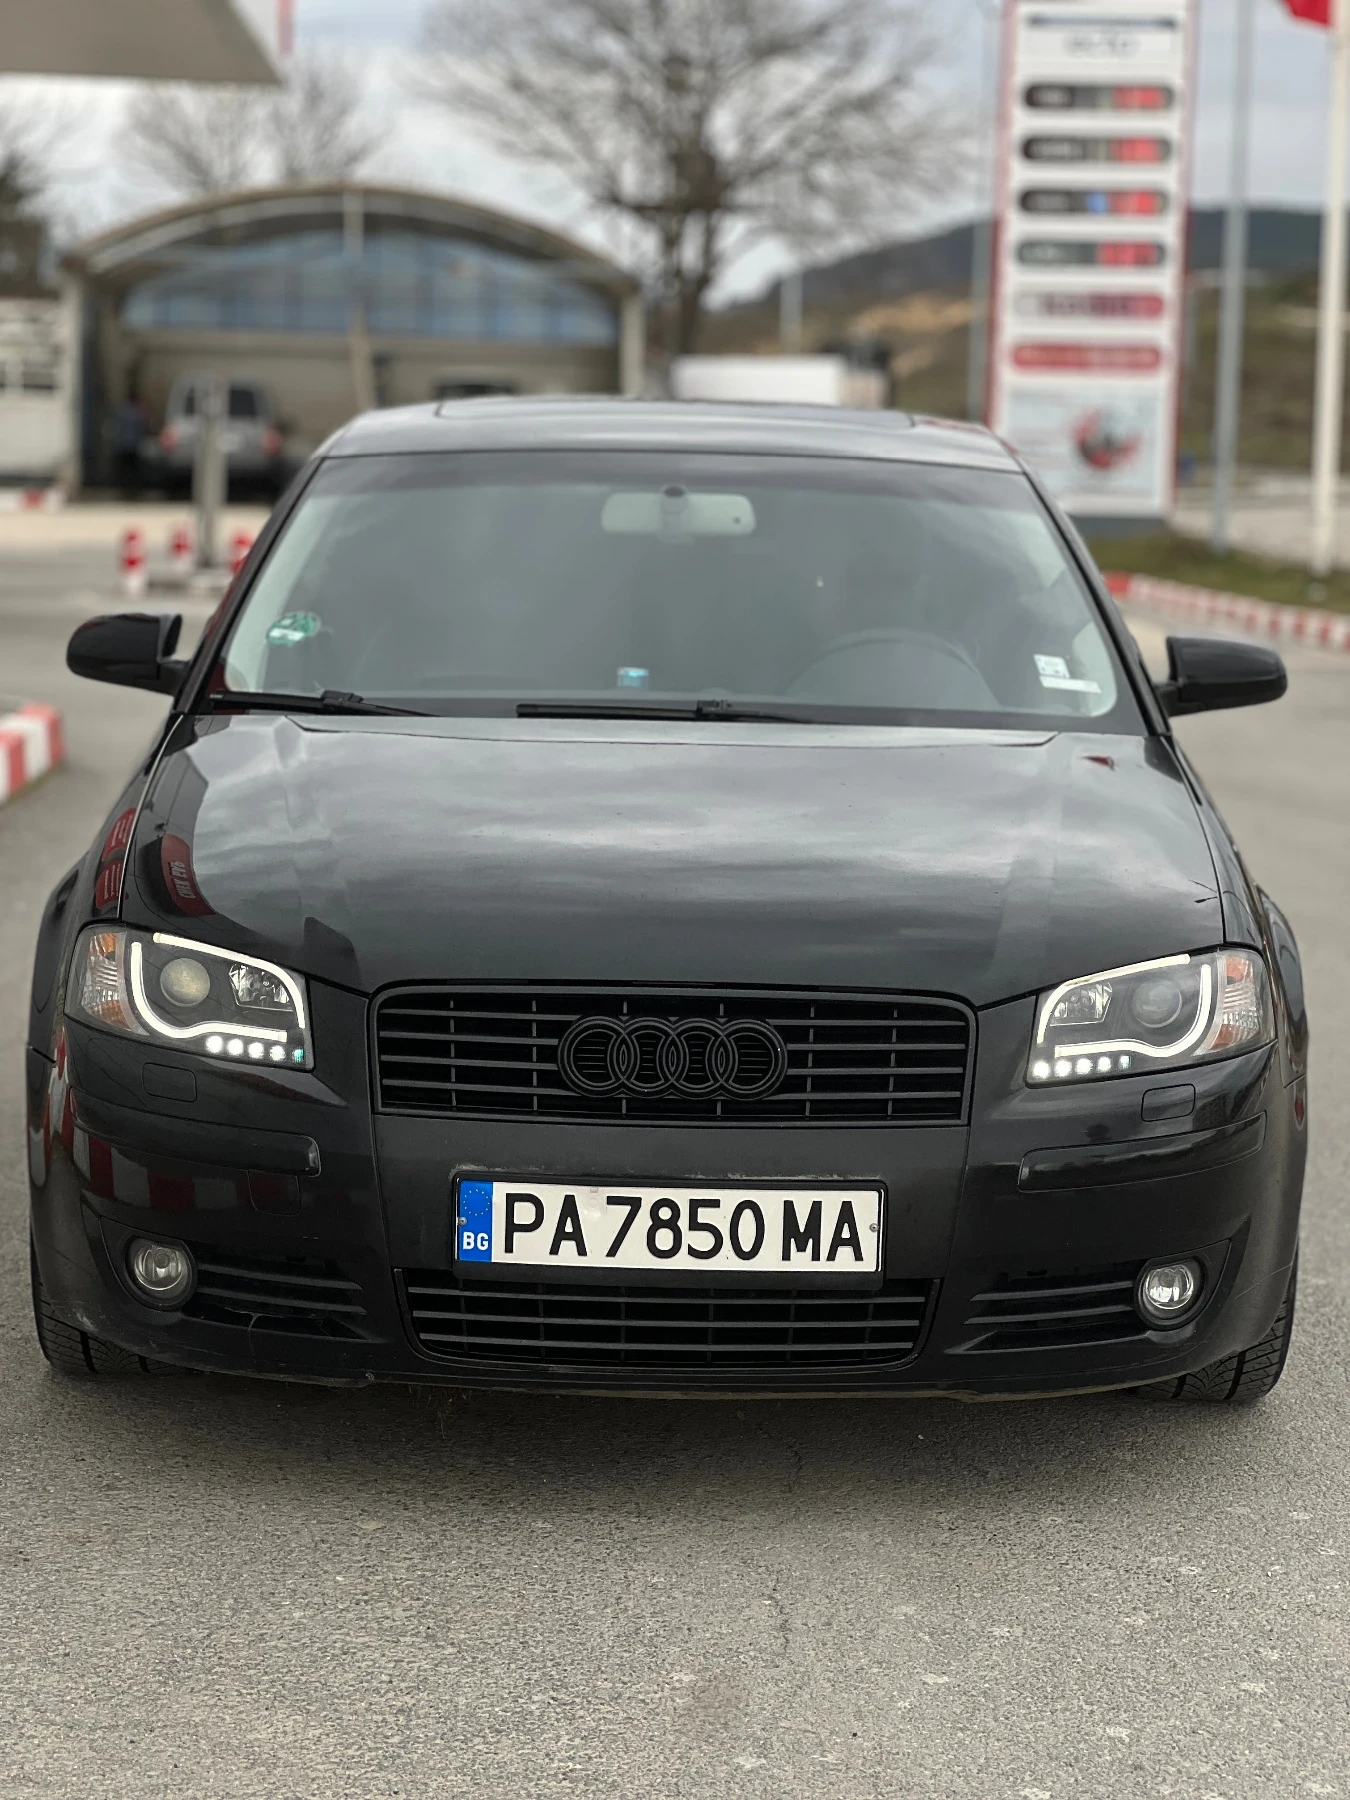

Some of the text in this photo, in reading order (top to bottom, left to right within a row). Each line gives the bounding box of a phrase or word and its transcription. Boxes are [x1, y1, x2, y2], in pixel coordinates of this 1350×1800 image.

[462, 1231, 489, 1251] BG
[504, 1192, 864, 1262] PA 7850 MA
